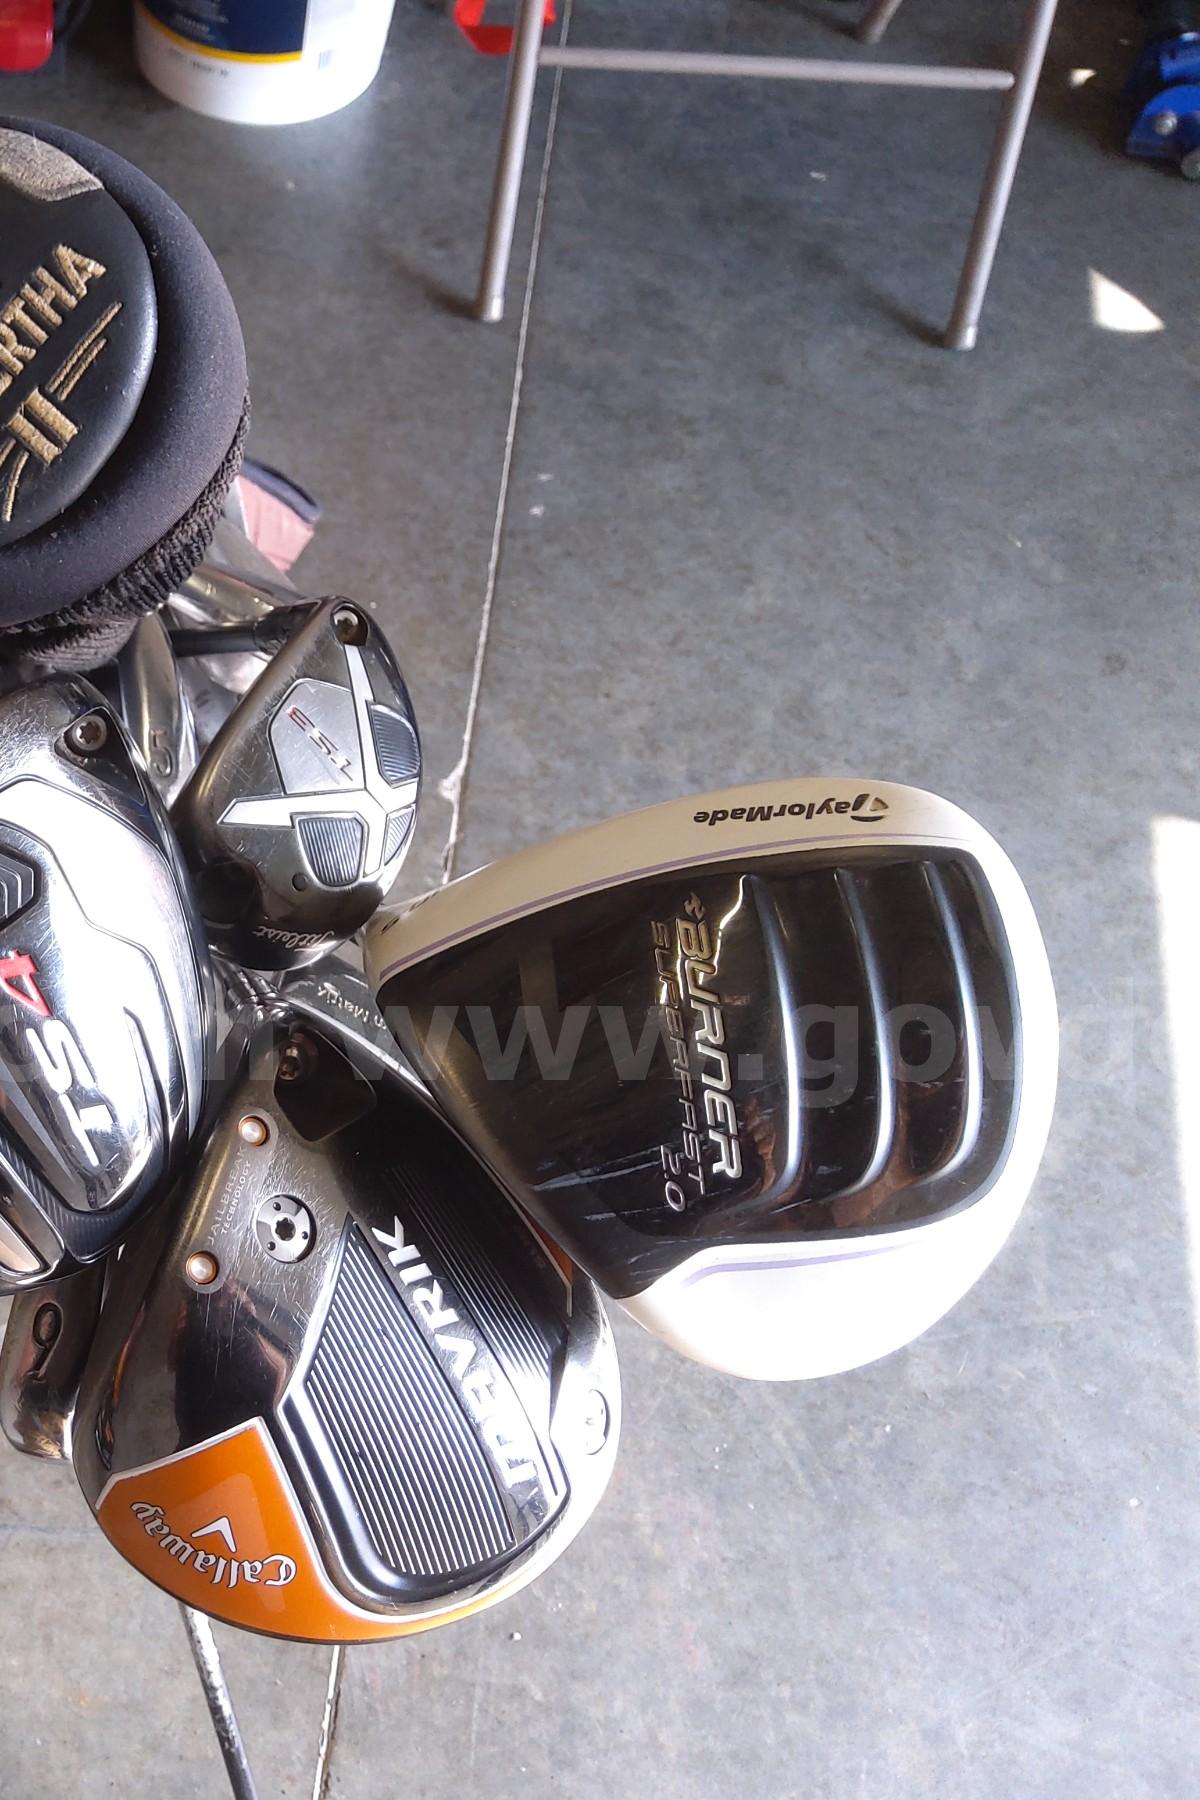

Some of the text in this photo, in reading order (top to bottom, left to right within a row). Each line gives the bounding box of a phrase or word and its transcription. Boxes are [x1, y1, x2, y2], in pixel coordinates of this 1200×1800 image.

[693, 793, 890, 827] TaylorMade
[650, 920, 706, 1196] SUPERFAST
[676, 917, 745, 1181] BURNER
[220, 1159, 253, 1237] TECHNOLOGY
[660, 1143, 688, 1214] 2.0
[128, 1499, 299, 1590] Callaway
